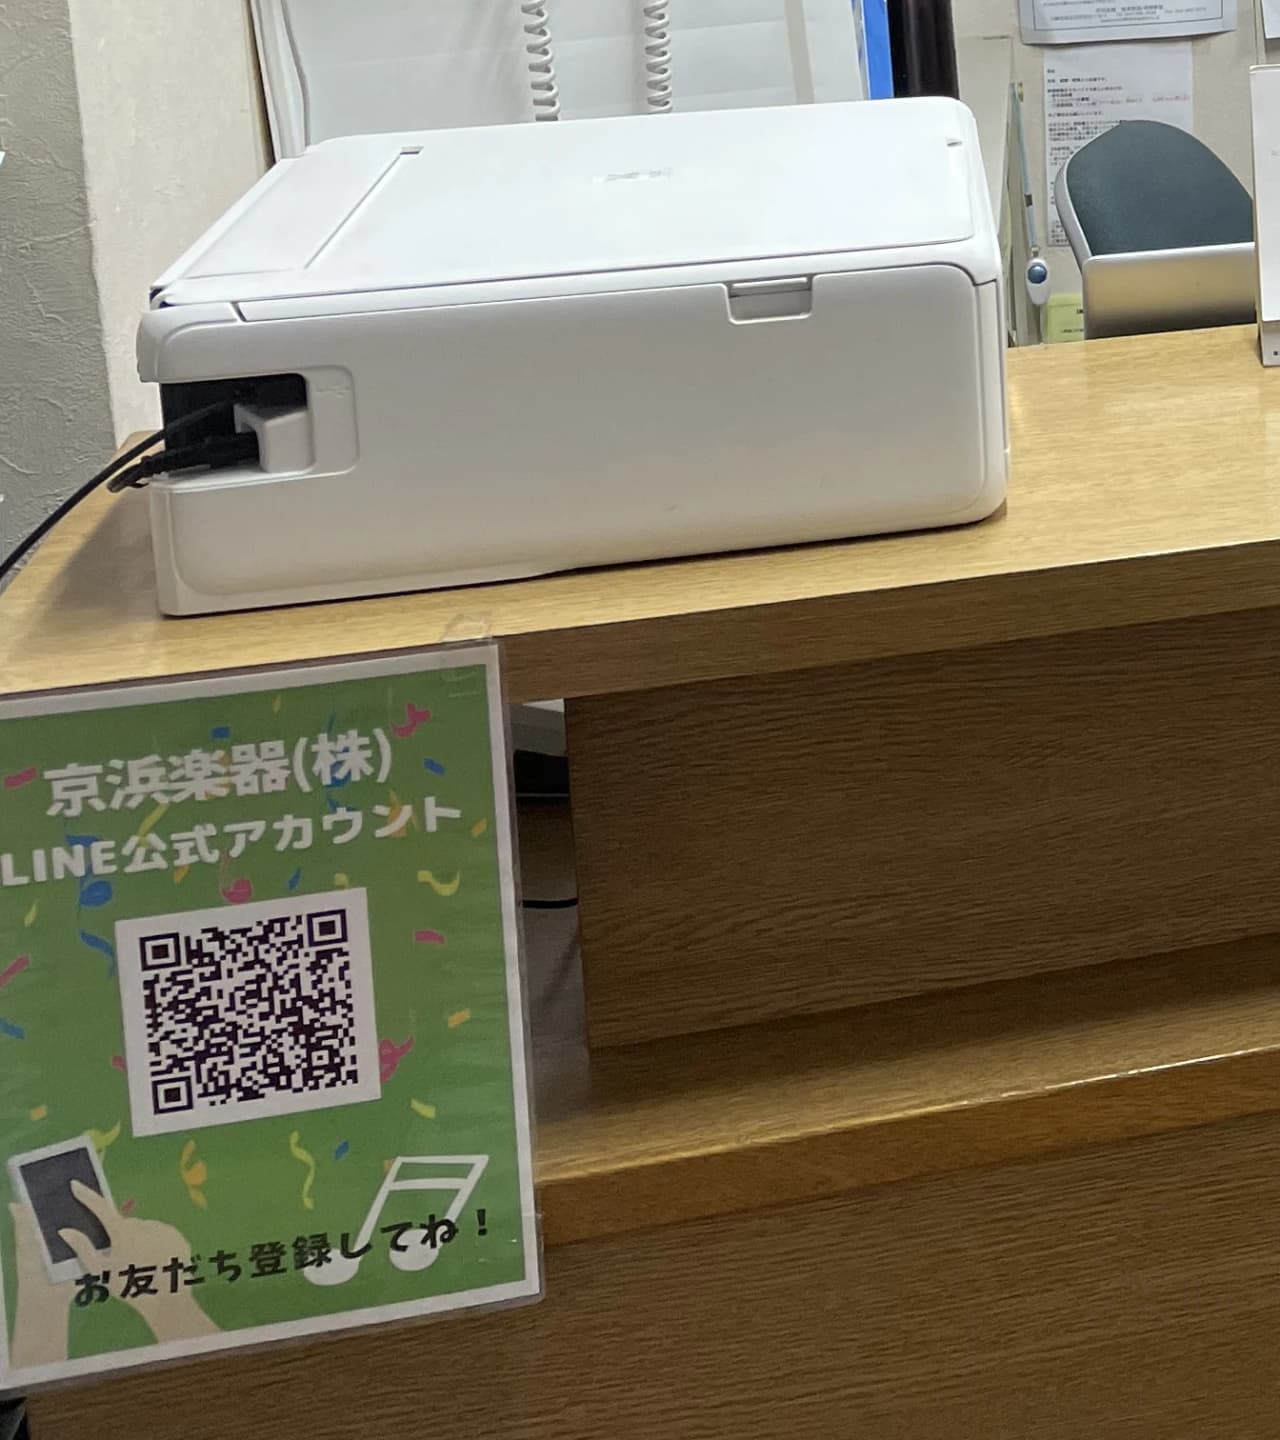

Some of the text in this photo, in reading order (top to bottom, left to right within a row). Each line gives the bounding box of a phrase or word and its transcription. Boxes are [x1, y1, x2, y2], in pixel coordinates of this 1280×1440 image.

[44, 726, 393, 819] 京浜楽器(株)
[0, 795, 464, 888] LINE公式アカウント
